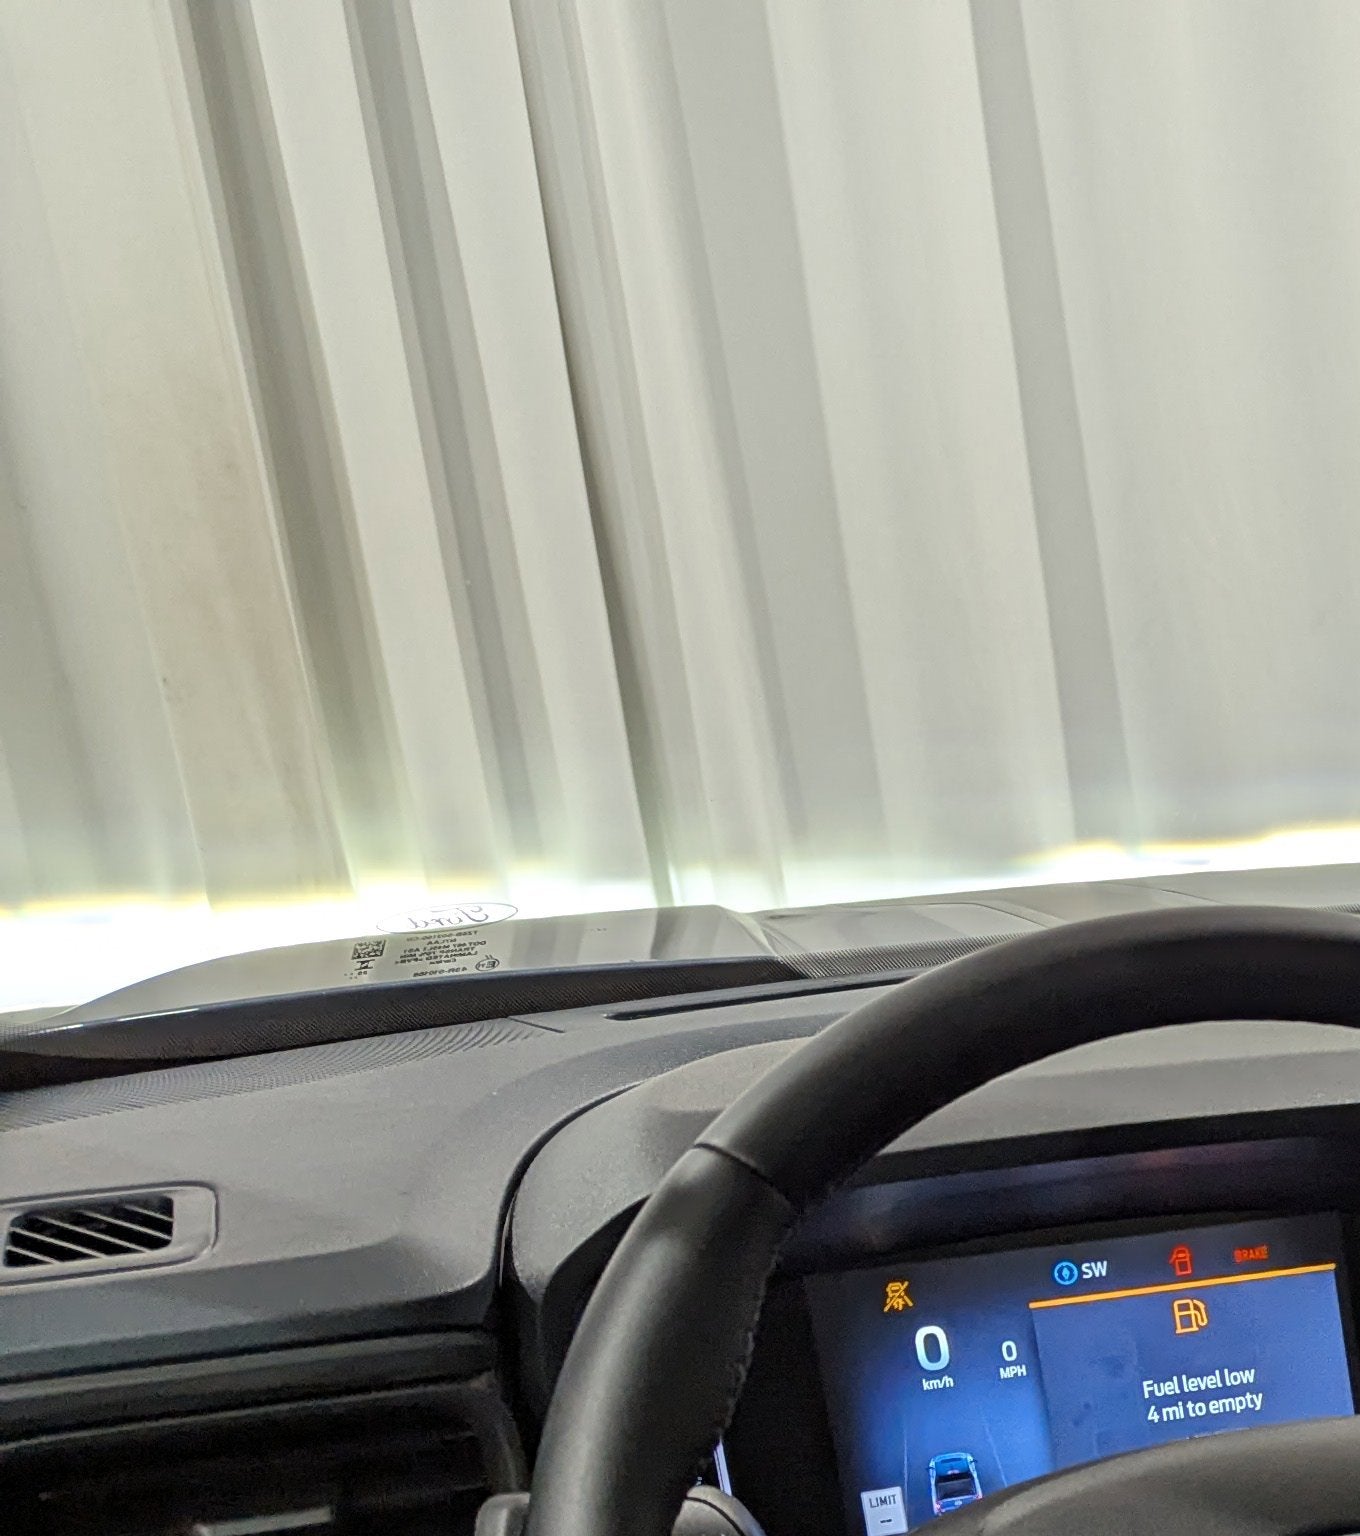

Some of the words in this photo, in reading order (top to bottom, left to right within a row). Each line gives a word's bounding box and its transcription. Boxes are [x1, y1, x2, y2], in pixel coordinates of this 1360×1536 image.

[1234, 1244, 1269, 1264] BRAKE
[1081, 1260, 1108, 1279] SW
[915, 1325, 950, 1371] 0
[1001, 1340, 1018, 1362] 0
[1000, 1364, 1027, 1379] MPH
[922, 1375, 954, 1391] km/h
[1142, 1375, 1181, 1399] Fuel
[1181, 1369, 1223, 1393] level
[1223, 1368, 1255, 1387] low
[1147, 1405, 1160, 1423] 4
[1162, 1401, 1185, 1421] mi
[1186, 1400, 1207, 1418] to
[1208, 1392, 1263, 1414] empty
[868, 1494, 897, 1508] LIMIT
